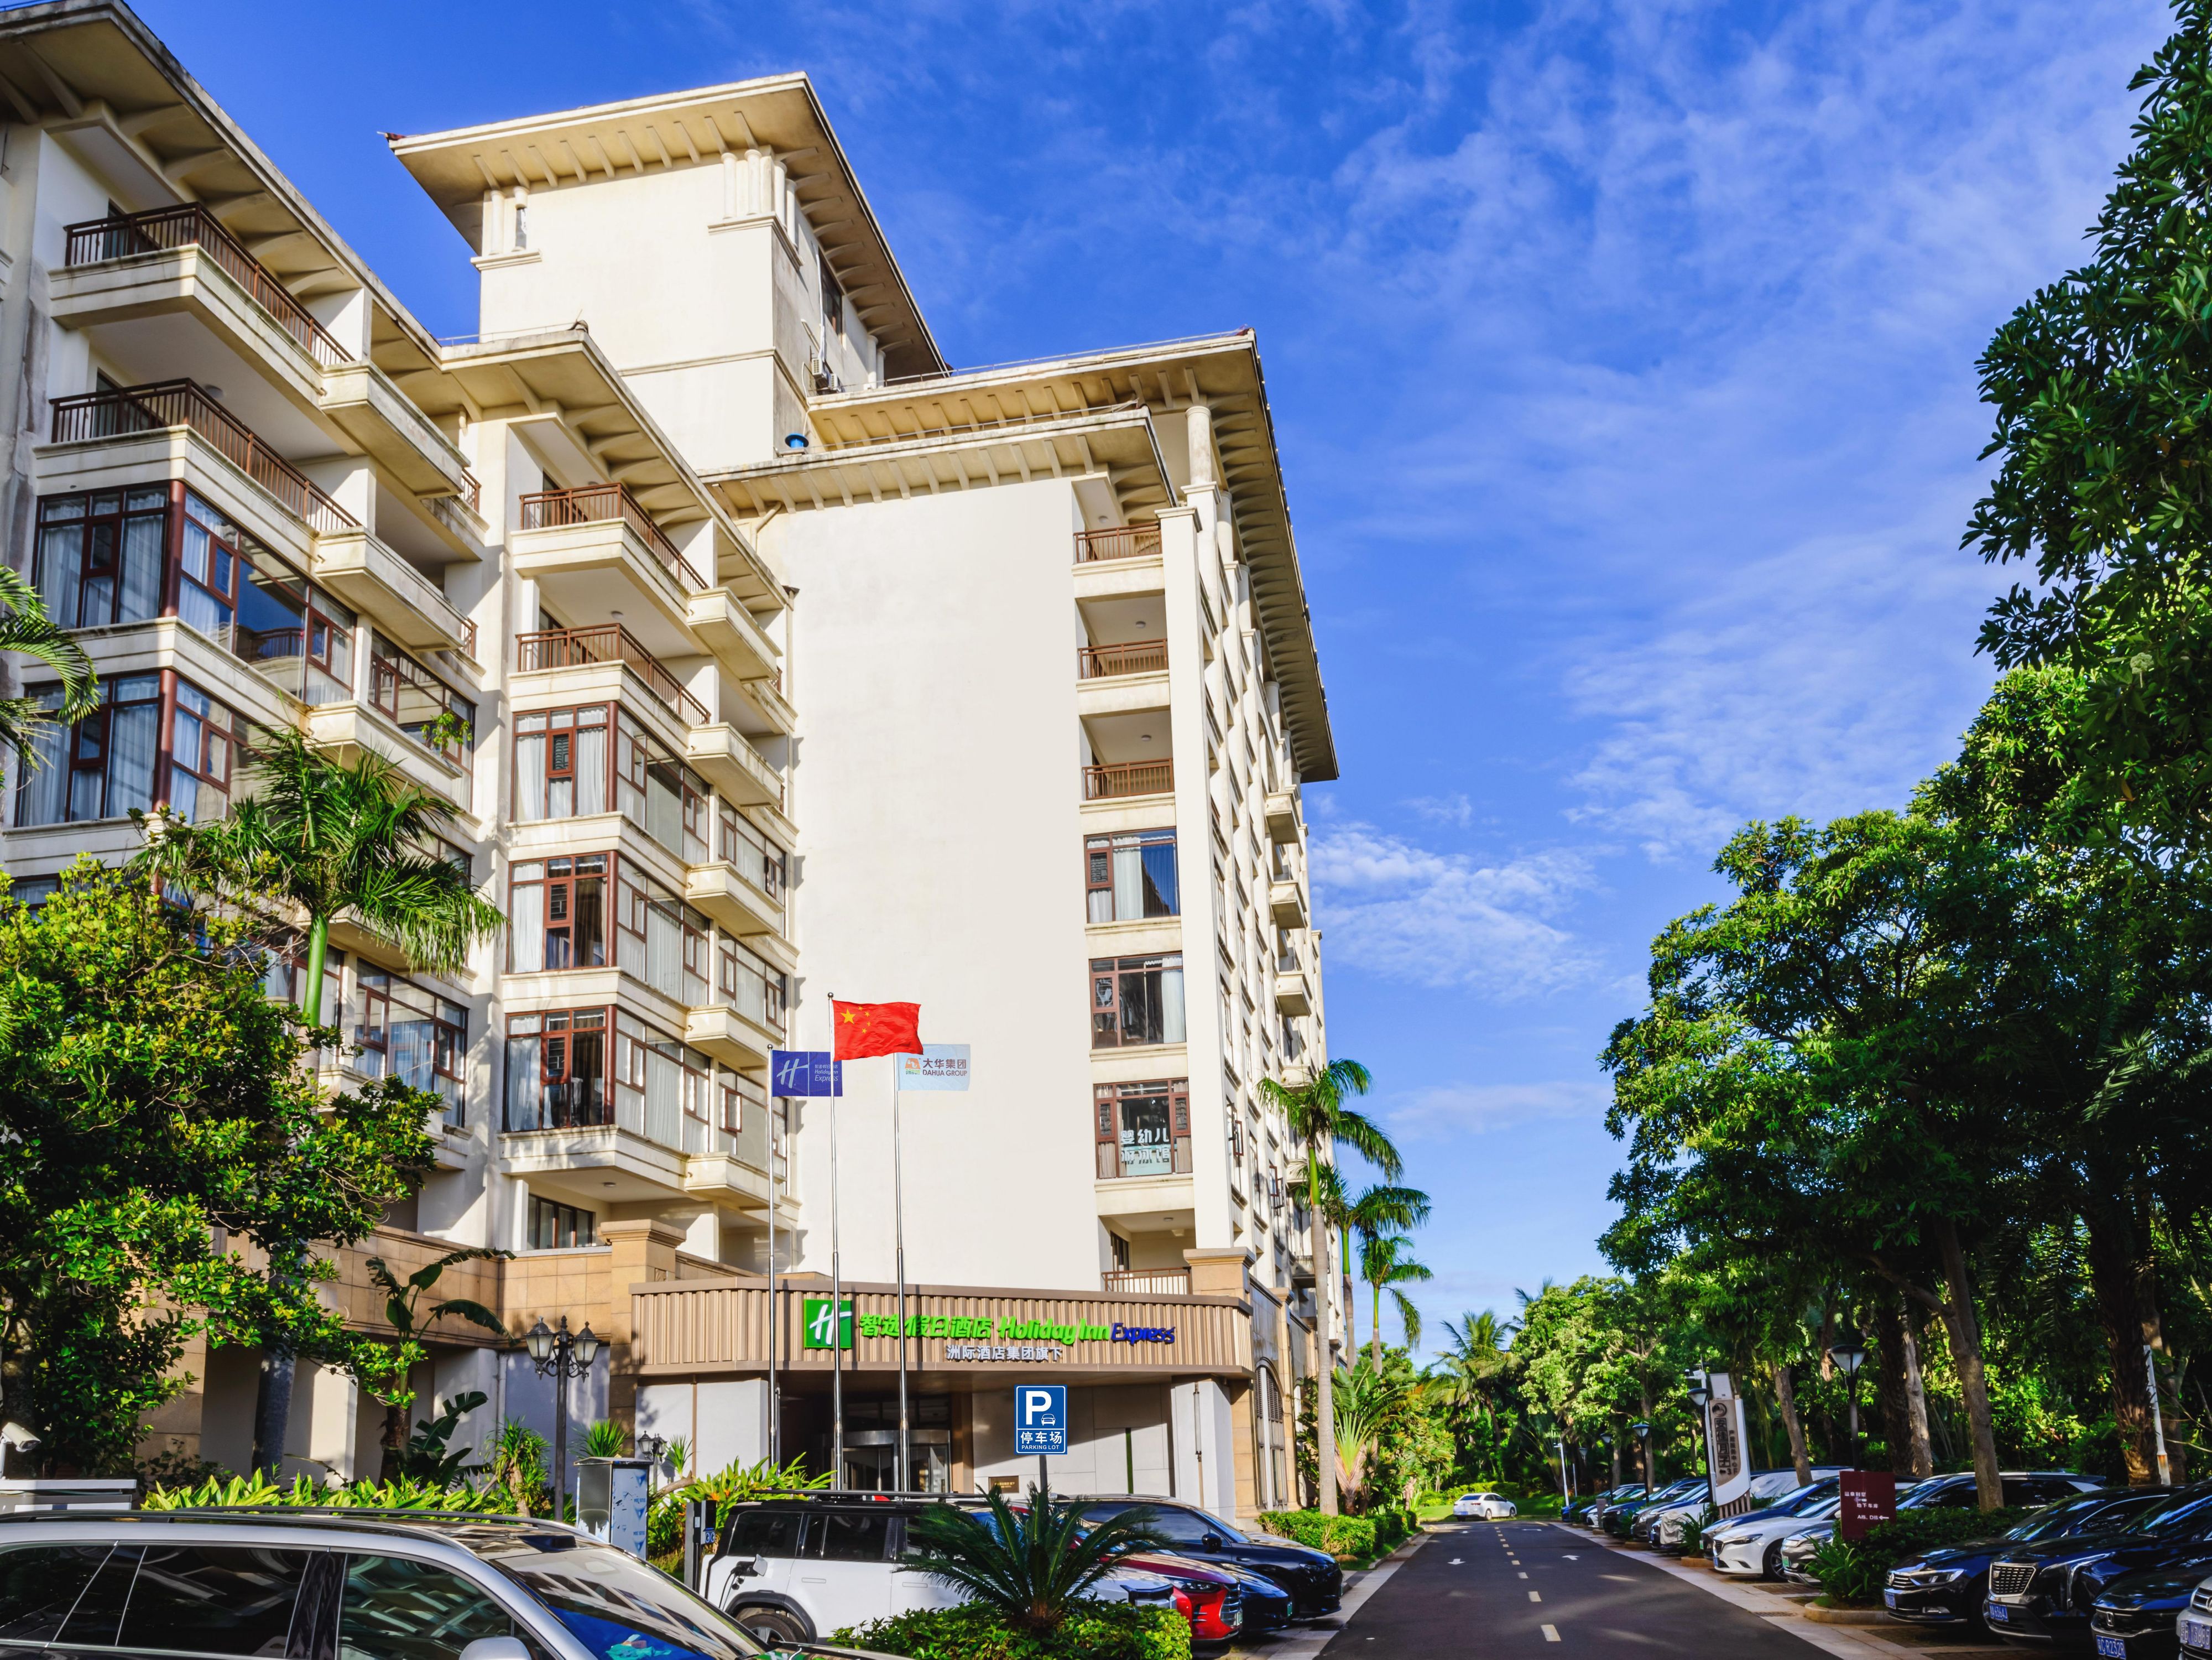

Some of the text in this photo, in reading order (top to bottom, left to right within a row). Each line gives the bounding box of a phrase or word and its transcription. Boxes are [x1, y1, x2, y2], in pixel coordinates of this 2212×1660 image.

[923, 1055, 966, 1069] 大华集团
[1121, 1128, 1170, 1144] 婴幼儿
[859, 1312, 1176, 1345] 智选假日酒店 Holiday Inn Express
[946, 1345, 1062, 1361] 洲际酒店集团旗下
[1026, 1391, 1052, 1425] P
[1020, 1431, 1062, 1444] 停车场
